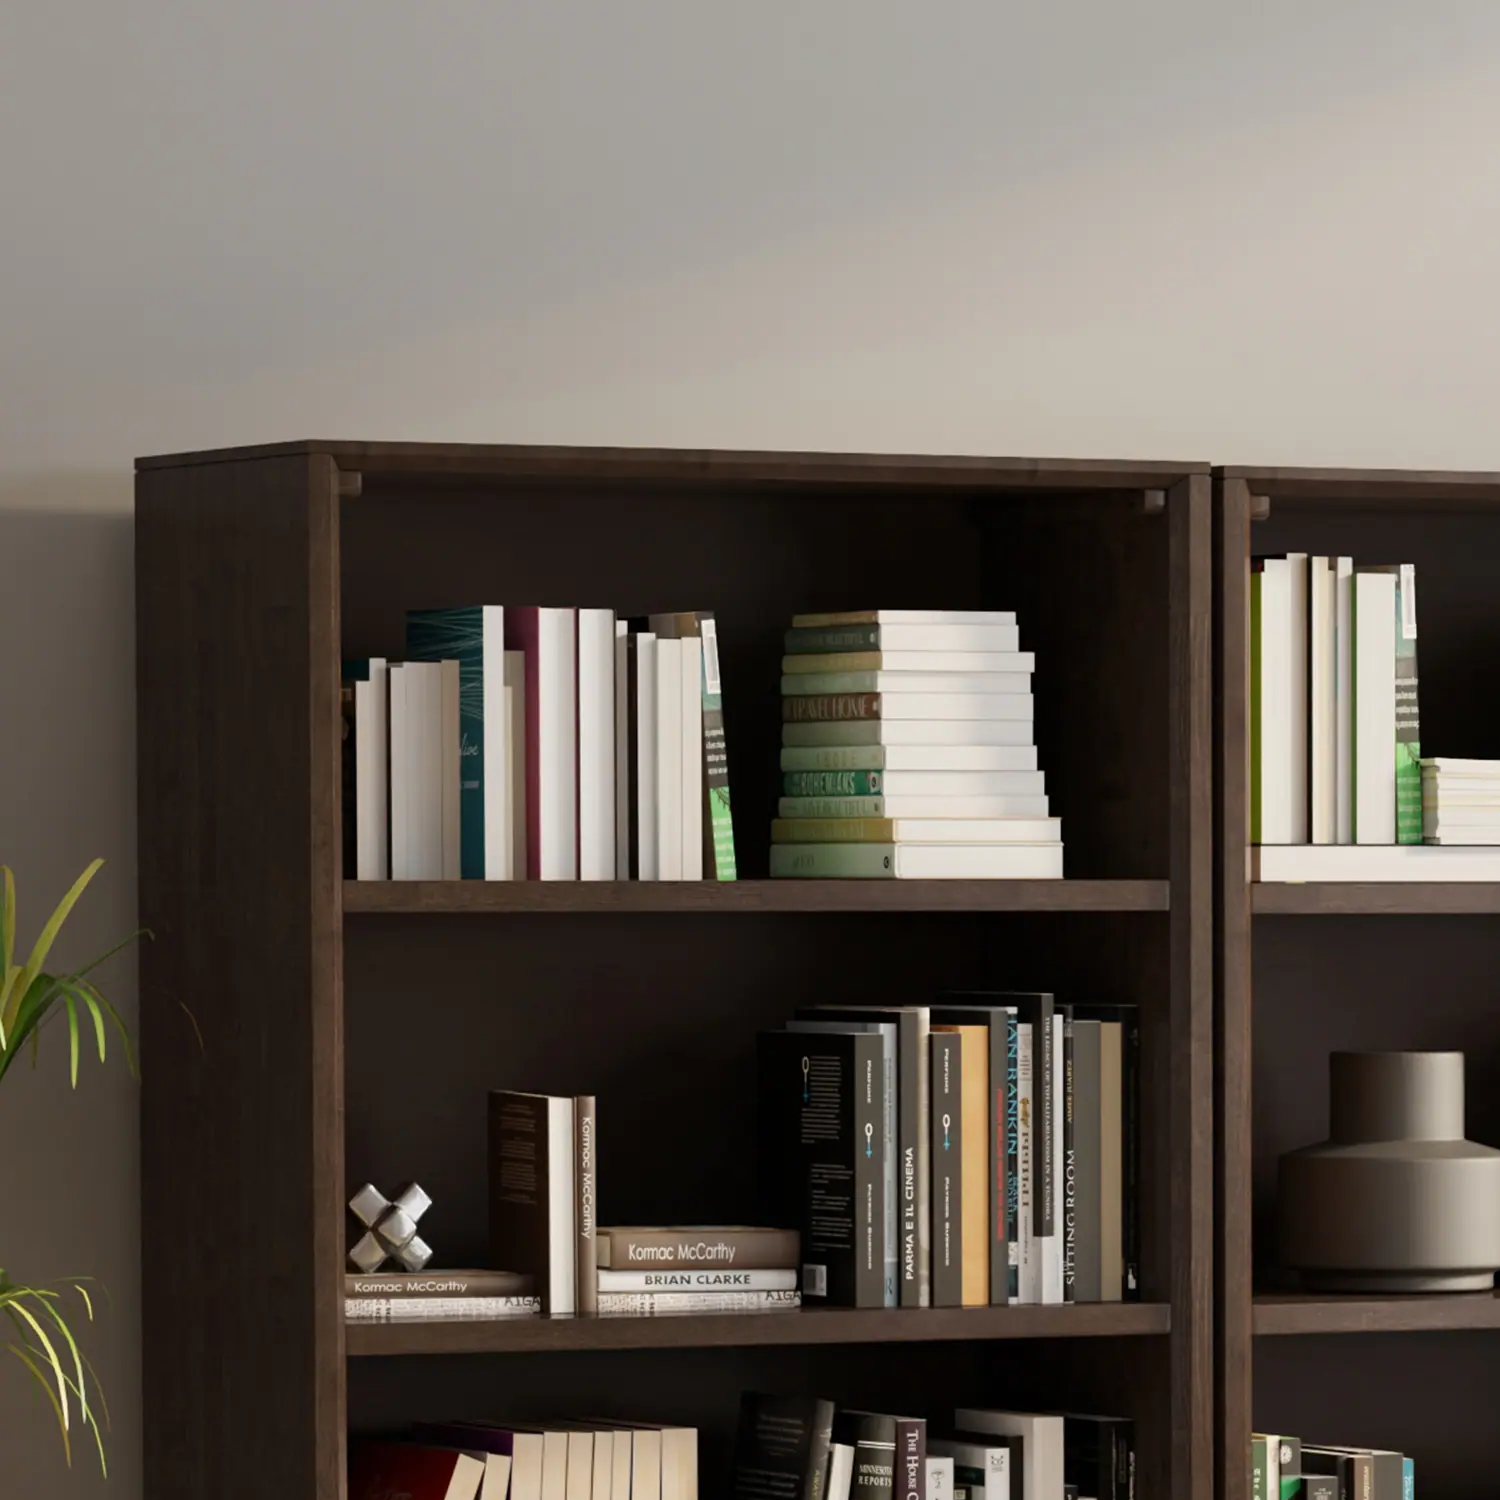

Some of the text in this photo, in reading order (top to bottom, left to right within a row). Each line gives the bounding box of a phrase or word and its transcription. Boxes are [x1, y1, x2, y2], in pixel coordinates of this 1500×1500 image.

[1007, 1020, 1017, 1154] IAN RANKIN
[581, 1117, 593, 1239] Kormac McCarthy
[906, 1147, 914, 1200] CINEMA
[906, 1204, 914, 1217] IL
[1067, 1150, 1075, 1285] SITTING ROOM
[629, 1243, 735, 1263] Kormac McCarthy
[906, 1234, 914, 1280] PARMA
[354, 1281, 467, 1292] Kormac McCarthy
[645, 1275, 751, 1285] BRIAN CLARKE
